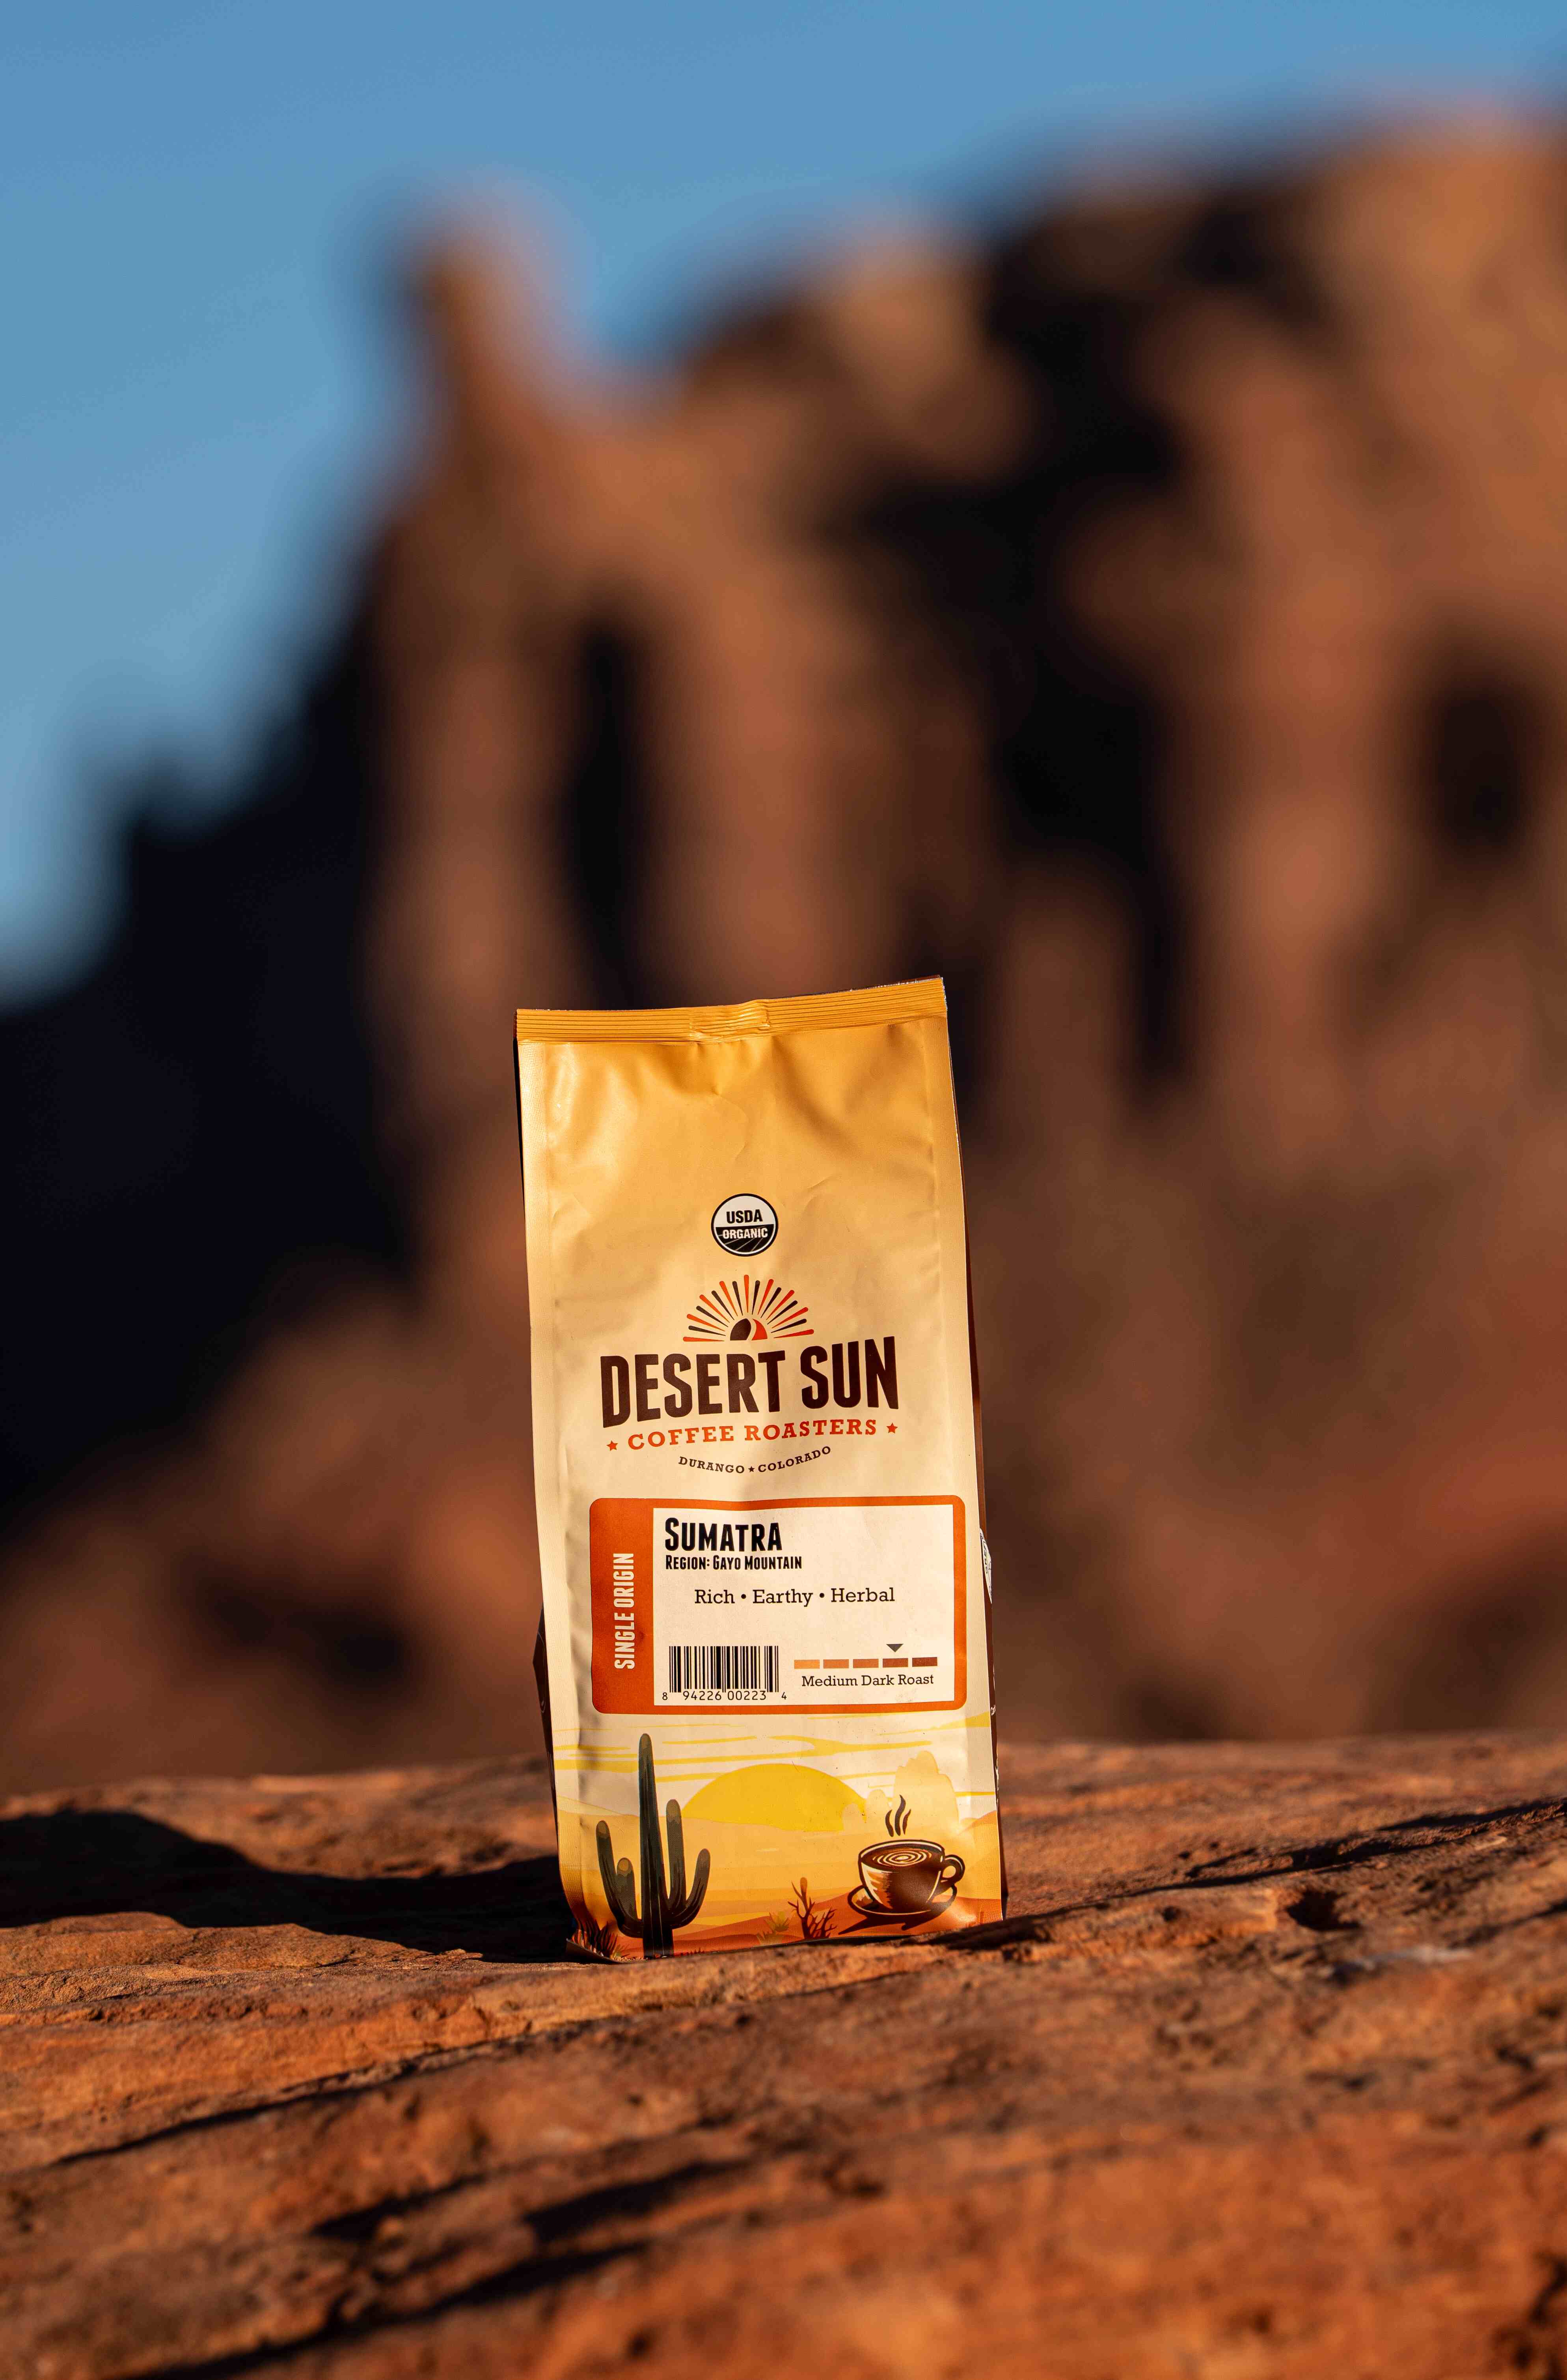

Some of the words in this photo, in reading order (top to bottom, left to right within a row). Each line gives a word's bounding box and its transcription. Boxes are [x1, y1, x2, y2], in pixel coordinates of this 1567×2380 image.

[726, 1209, 763, 1224] USDA
[723, 1227, 768, 1239] ORGANIC
[600, 1350, 786, 1429] DESERT
[800, 1335, 899, 1410] SUN
[628, 1425, 734, 1450] COFFEE
[744, 1419, 876, 1441] ROASTERS
[678, 1456, 745, 1474] DURANGO
[758, 1446, 831, 1473] COLORADO
[613, 1553, 635, 1608] ORIGIN
[694, 1589, 736, 1604] Rich
[753, 1589, 814, 1608] Earthy
[830, 1587, 895, 1603] Herbal
[614, 1612, 635, 1670] SINGLE
[801, 1675, 859, 1686] Medium
[861, 1674, 895, 1686] Dark
[898, 1674, 934, 1685] Roast
[662, 1692, 668, 1701] 8
[682, 1691, 722, 1701] 94226
[727, 1690, 767, 1701] 00223
[781, 1691, 787, 1700] 4
